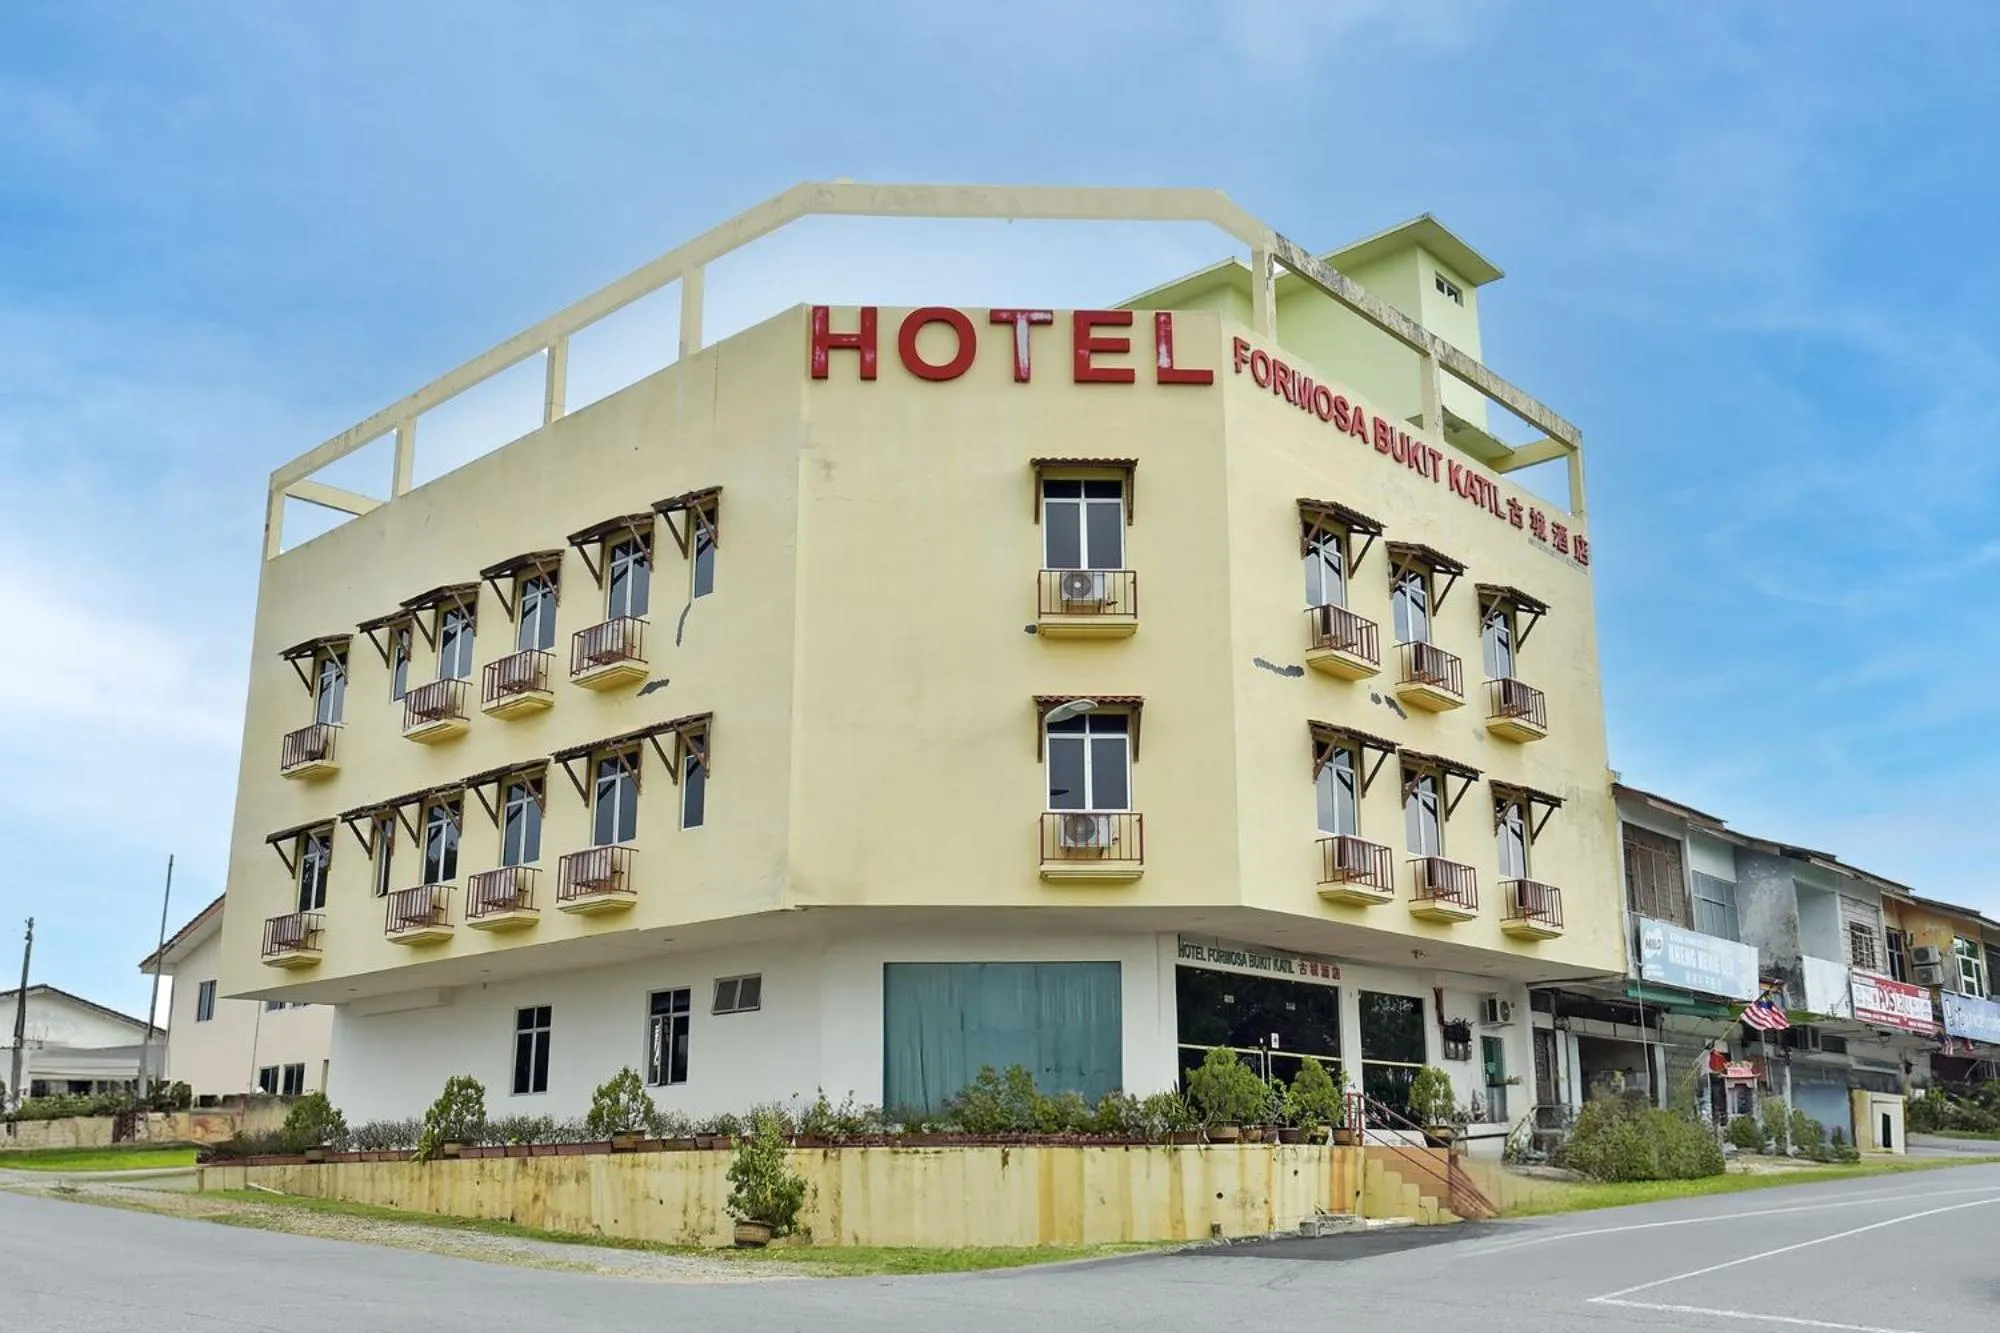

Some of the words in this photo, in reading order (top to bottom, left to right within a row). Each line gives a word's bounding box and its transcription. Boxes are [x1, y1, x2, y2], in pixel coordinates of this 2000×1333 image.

[812, 306, 1213, 384] HOTEL
[1233, 336, 1369, 444] FORMOSA
[1373, 416, 1443, 483] BUKIT
[1448, 458, 1506, 520] KATIL
[1178, 941, 1206, 961] HOTEL
[1207, 948, 1248, 968] FORMOSA
[1249, 953, 1271, 970] BUKIT
[1272, 957, 1295, 974] KATIL
